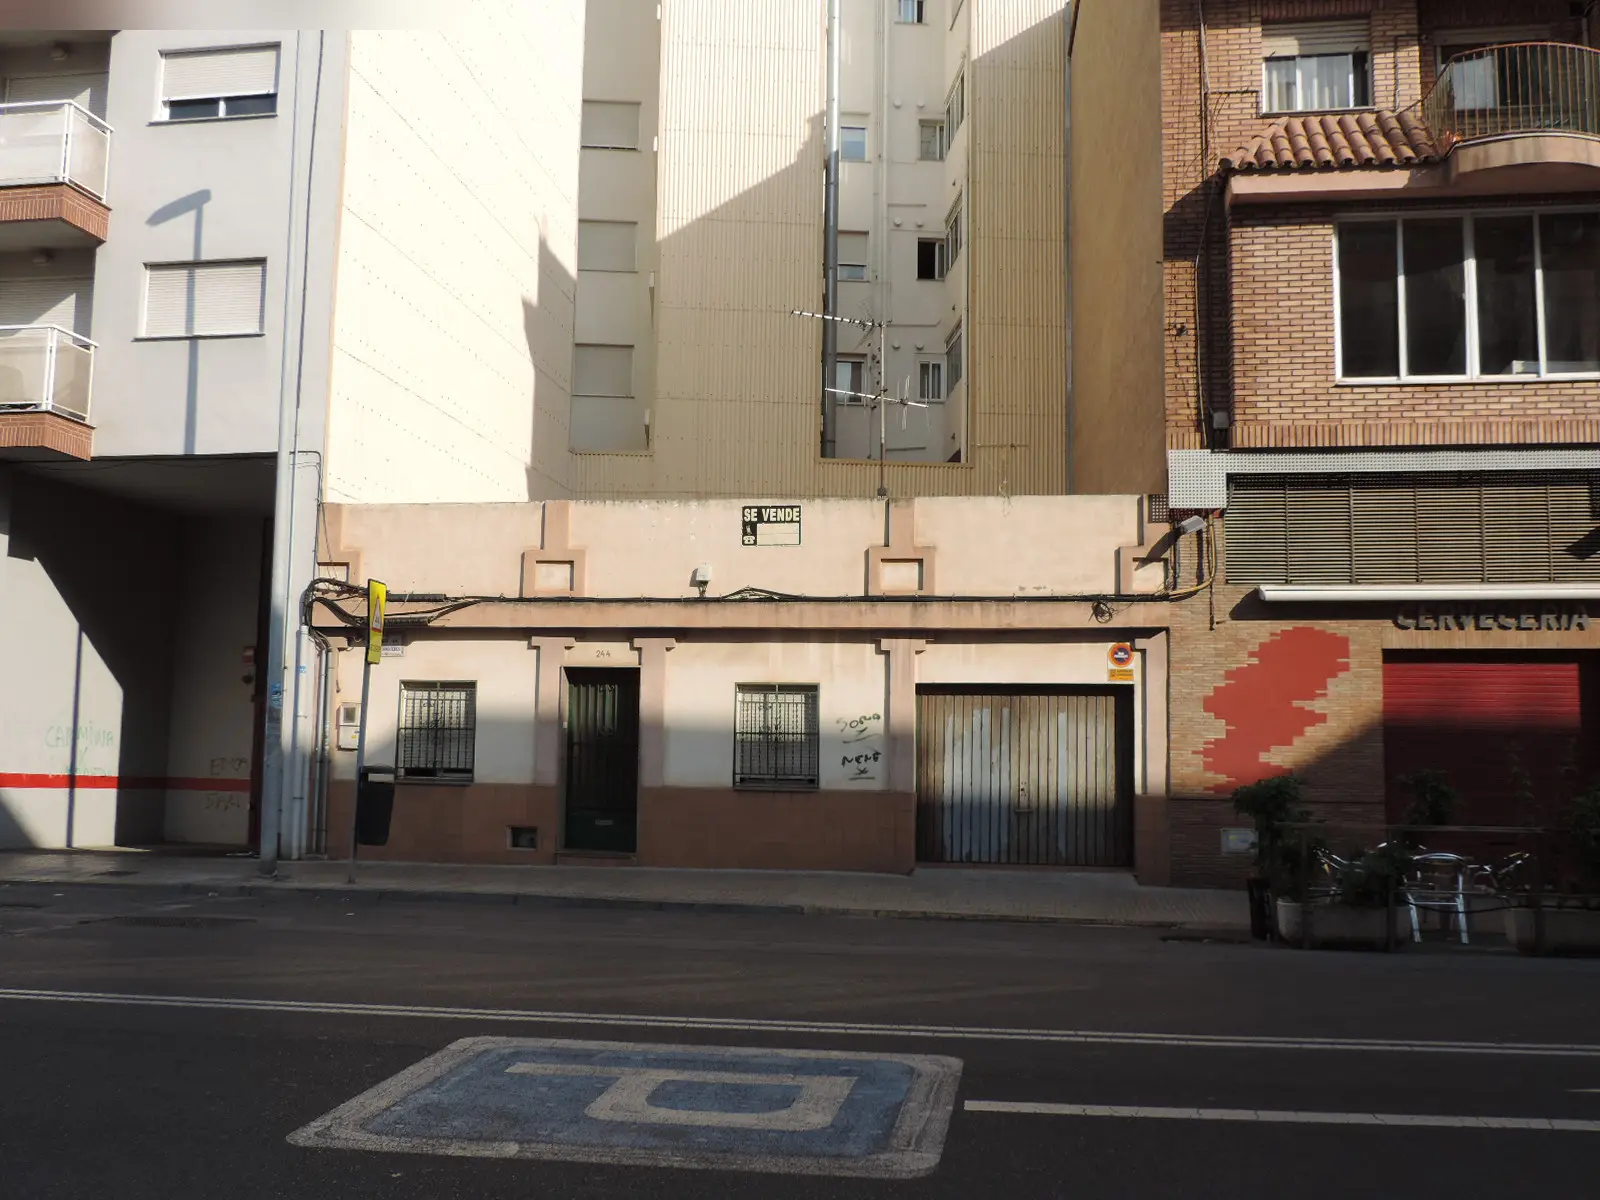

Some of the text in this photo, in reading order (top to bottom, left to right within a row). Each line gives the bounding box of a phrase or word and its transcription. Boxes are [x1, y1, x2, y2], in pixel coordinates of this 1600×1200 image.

[743, 507, 800, 522] SE VENDE
[1394, 604, 1590, 631] CERVECERIA
[595, 649, 611, 658] 244
